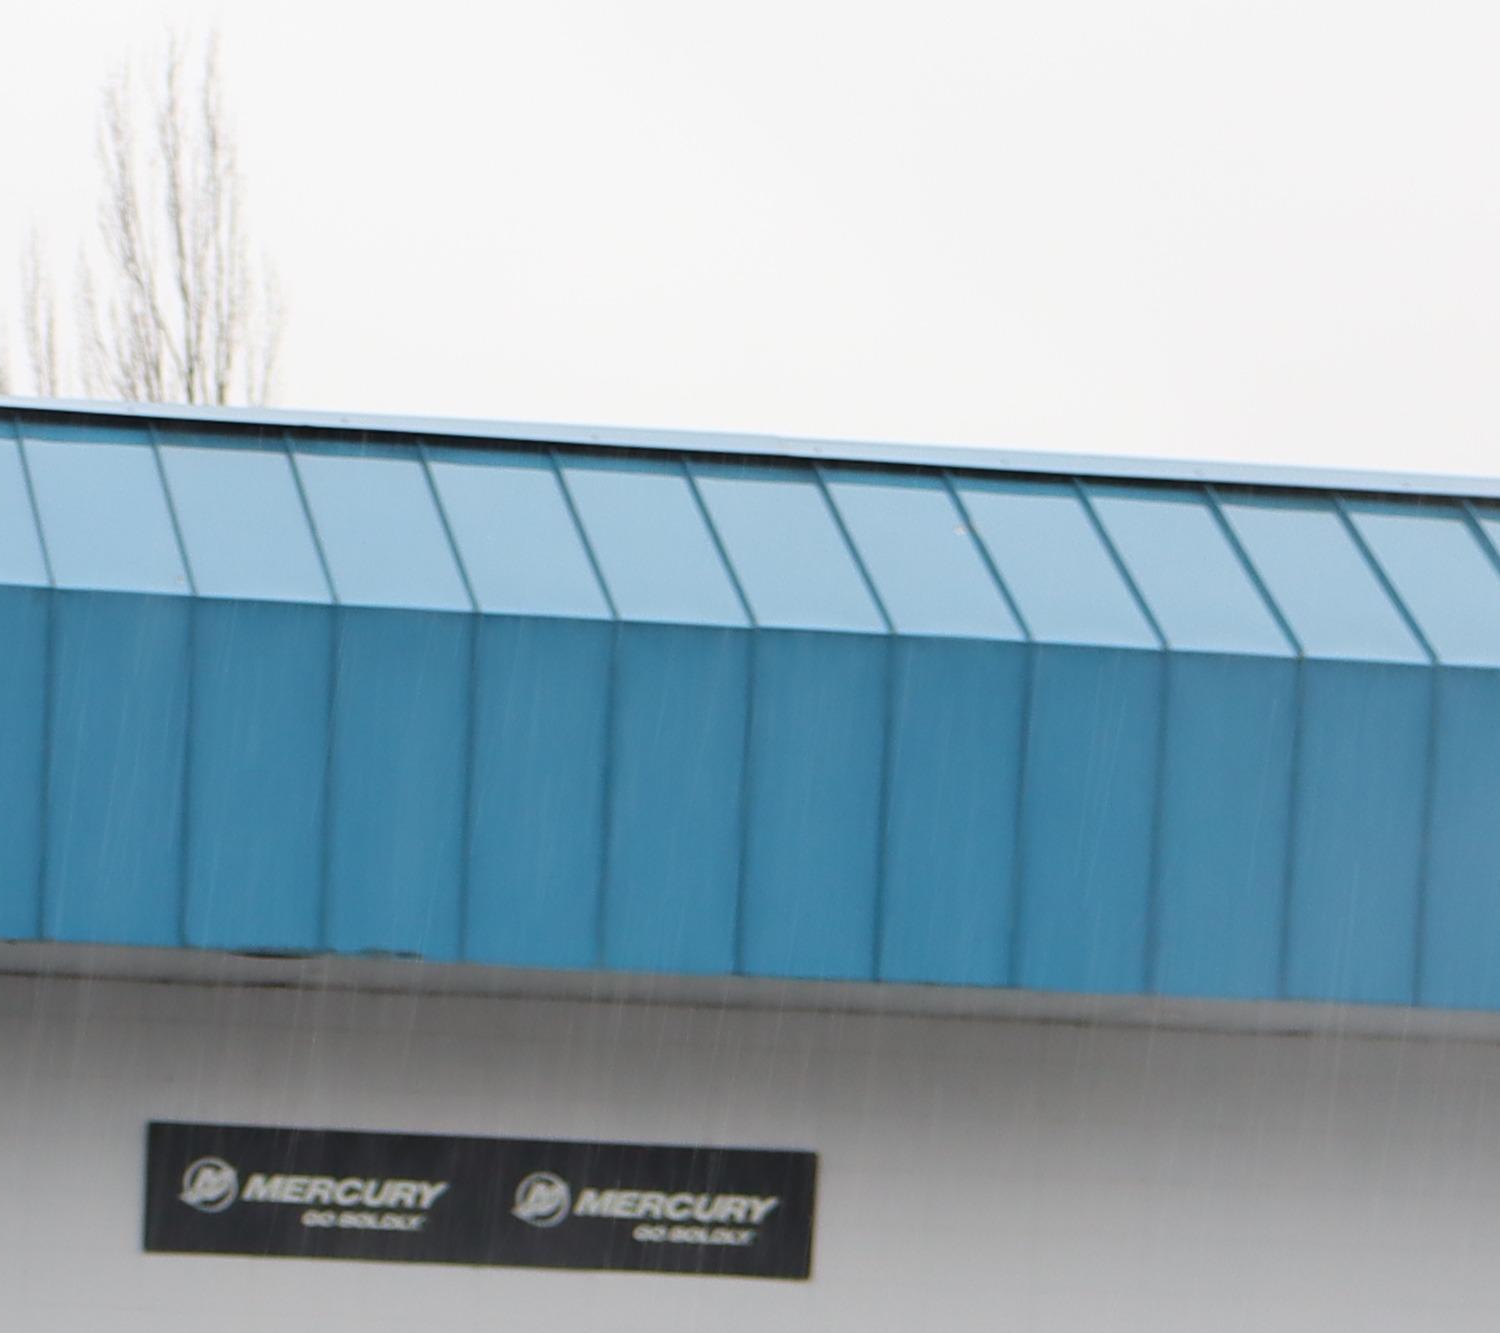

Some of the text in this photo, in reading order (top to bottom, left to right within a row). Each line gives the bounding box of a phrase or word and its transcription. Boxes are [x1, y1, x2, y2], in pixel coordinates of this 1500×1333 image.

[242, 1174, 447, 1209] MERCURY
[301, 1209, 425, 1230] GO BOLDLY
[574, 1189, 778, 1224] MERCURY
[632, 1223, 755, 1246] GO BOLDLY
